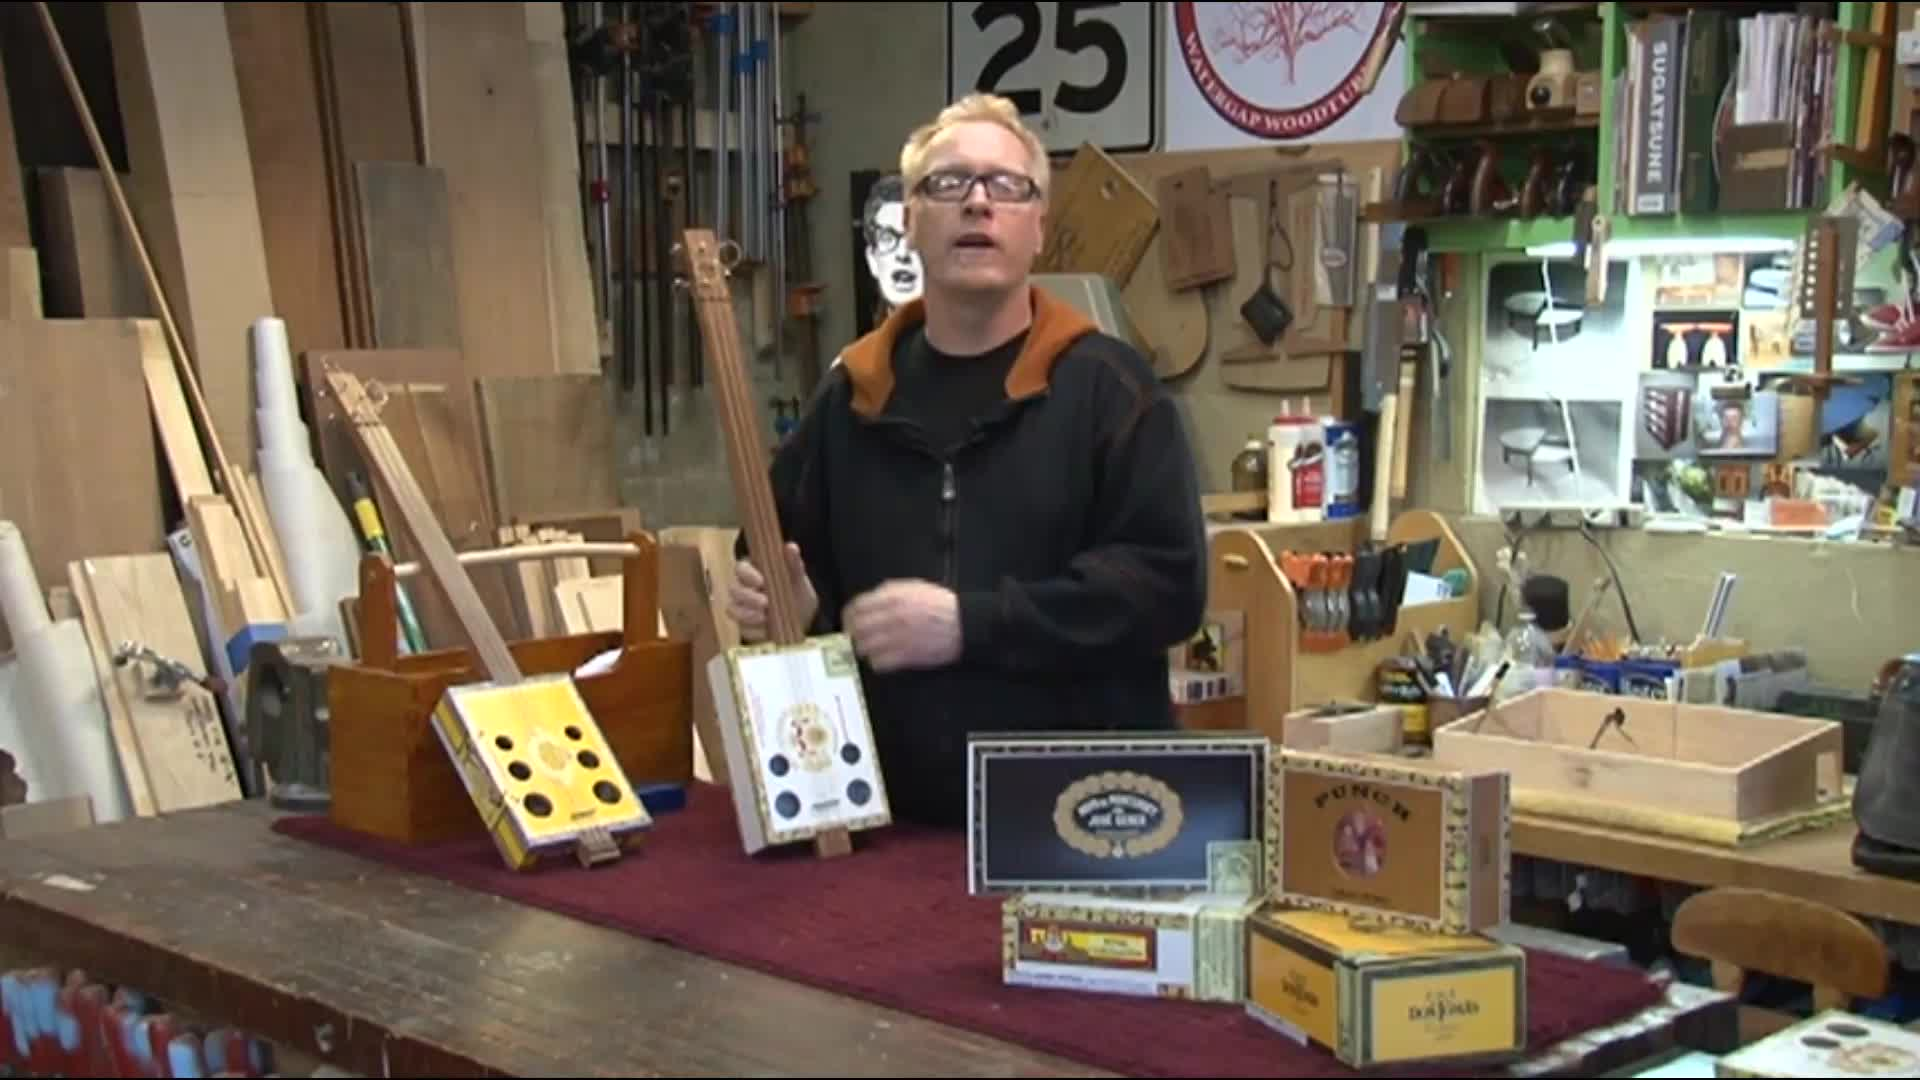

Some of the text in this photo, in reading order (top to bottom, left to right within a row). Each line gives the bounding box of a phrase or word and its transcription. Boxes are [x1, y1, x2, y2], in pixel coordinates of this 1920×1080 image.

[971, 2, 1127, 115] 25
[1185, 31, 1262, 127] WATERGAP
[1646, 40, 1669, 184] SUGATSUNE
[1313, 783, 1412, 823] PUNCH
